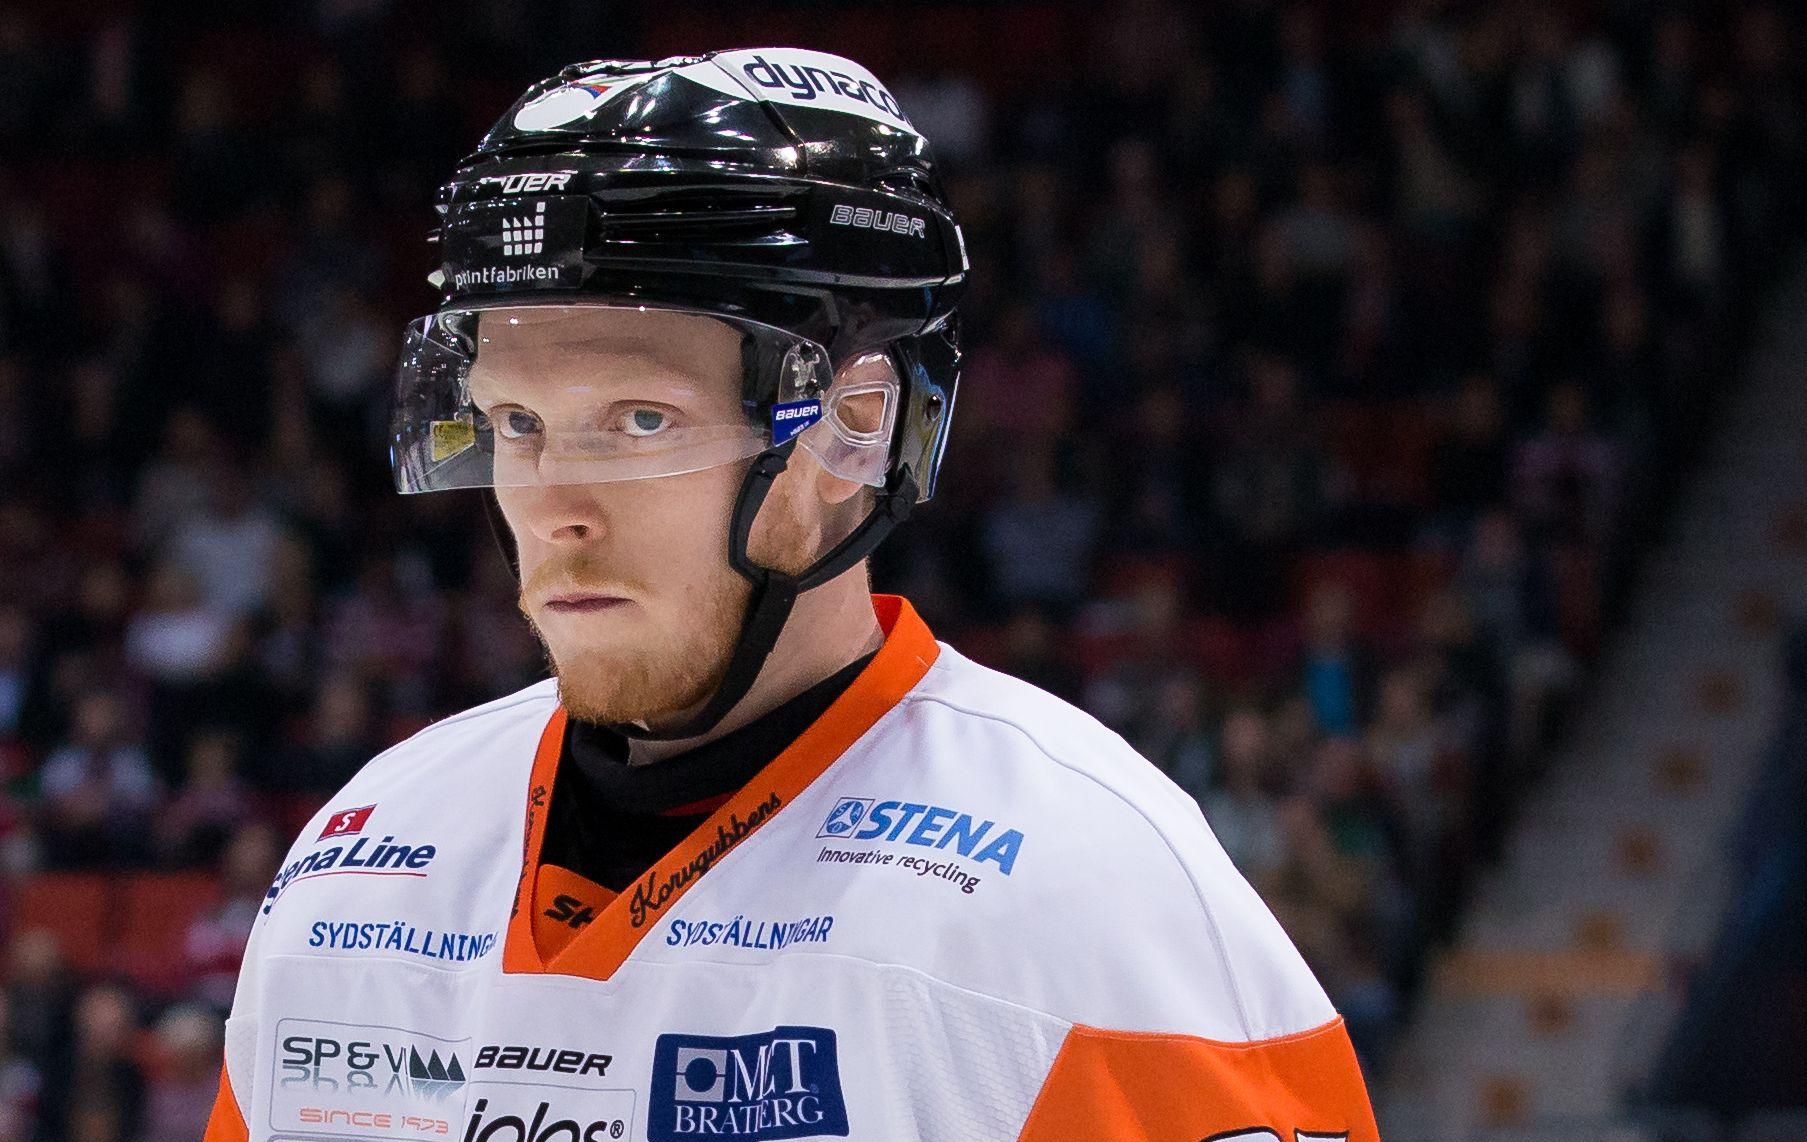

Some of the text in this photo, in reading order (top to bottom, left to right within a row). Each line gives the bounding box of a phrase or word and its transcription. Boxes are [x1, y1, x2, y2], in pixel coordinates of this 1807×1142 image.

[480, 173, 572, 195] UER
[830, 204, 926, 239] BAUER
[455, 263, 560, 290] printfabriken
[775, 405, 819, 421] BAUER
[338, 835, 437, 869] Line
[855, 800, 1025, 876] STENA
[816, 845, 982, 895] Innovative recycling
[308, 919, 500, 962] SYDSTÄLLNING
[473, 1045, 613, 1077] BAUER
[299, 1108, 392, 1128] SINCE
